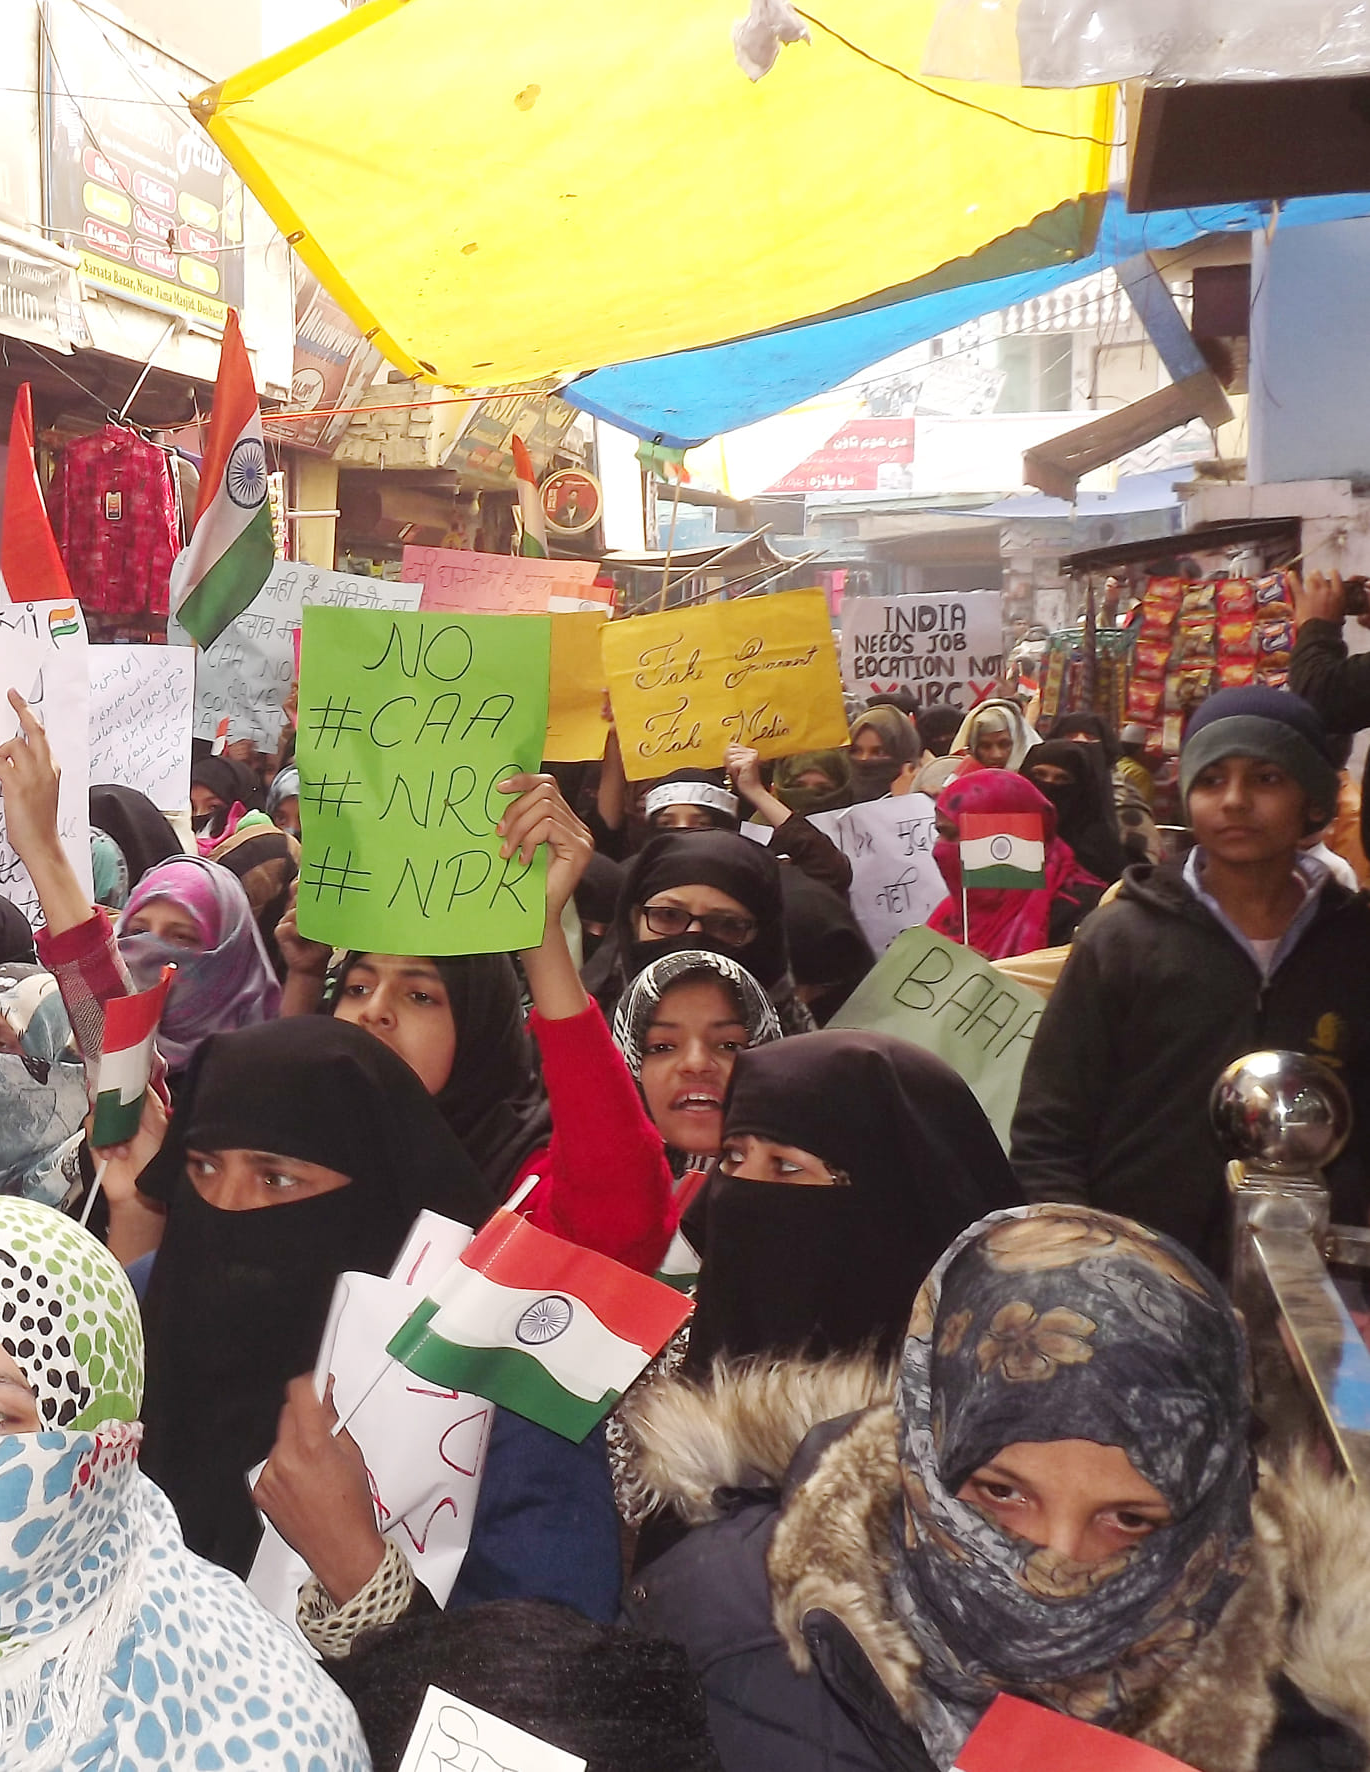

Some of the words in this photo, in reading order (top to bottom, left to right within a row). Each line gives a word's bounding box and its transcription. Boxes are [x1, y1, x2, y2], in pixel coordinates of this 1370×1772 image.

[136, 278, 153, 296] Near
[156, 285, 172, 303] Jama
[882, 603, 967, 633] INDIA
[362, 622, 473, 682] NO
[854, 634, 915, 655] NEEDS
[926, 632, 967, 653] JOB
[968, 655, 1005, 677] NOT
[899, 681, 964, 711] NRC
